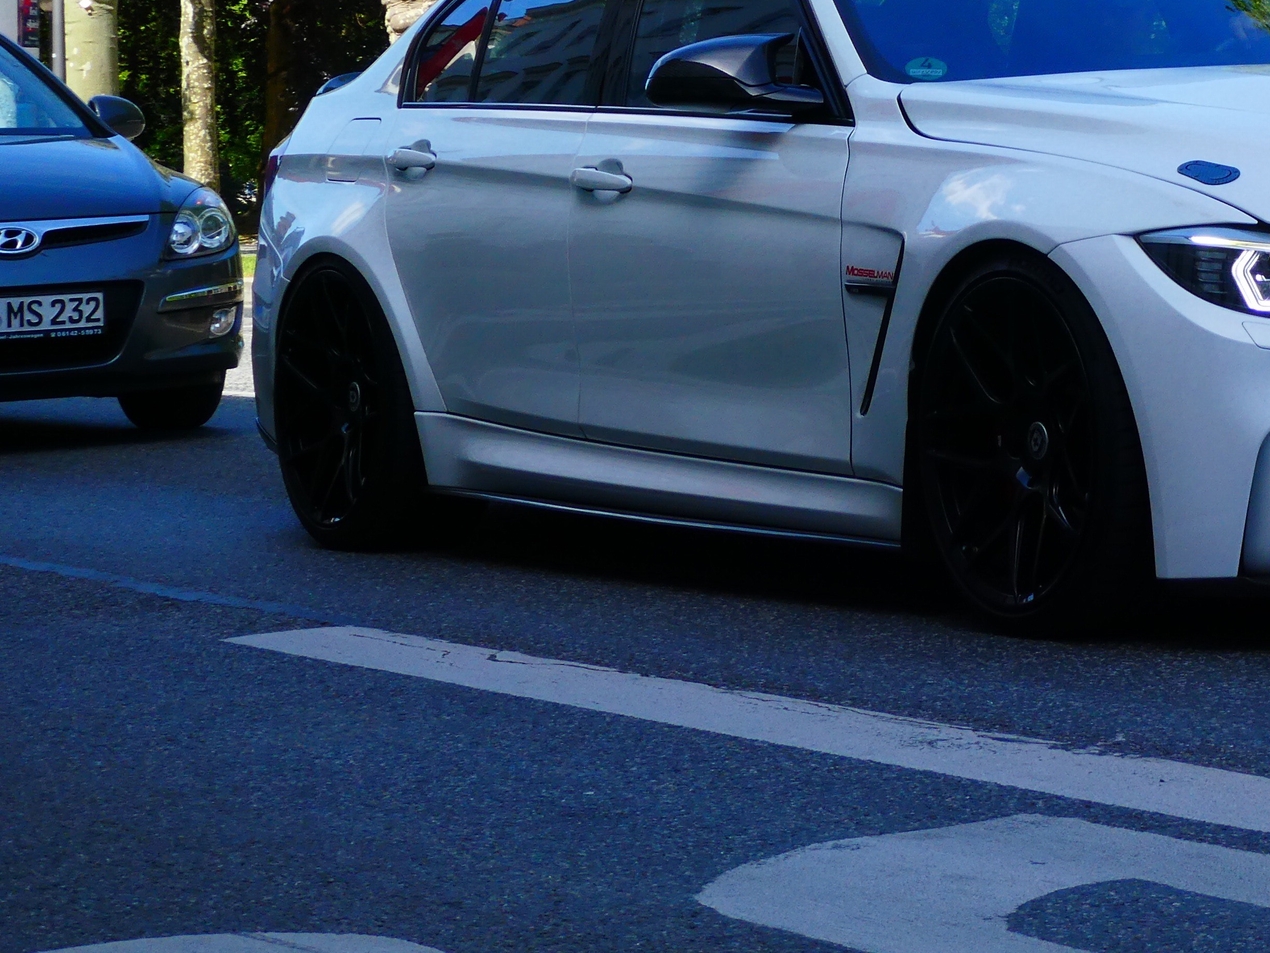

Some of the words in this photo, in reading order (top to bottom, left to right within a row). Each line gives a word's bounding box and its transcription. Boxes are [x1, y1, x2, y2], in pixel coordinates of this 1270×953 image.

[920, 58, 932, 69] 4
[7, 299, 43, 328] MS
[50, 296, 101, 326] 232
